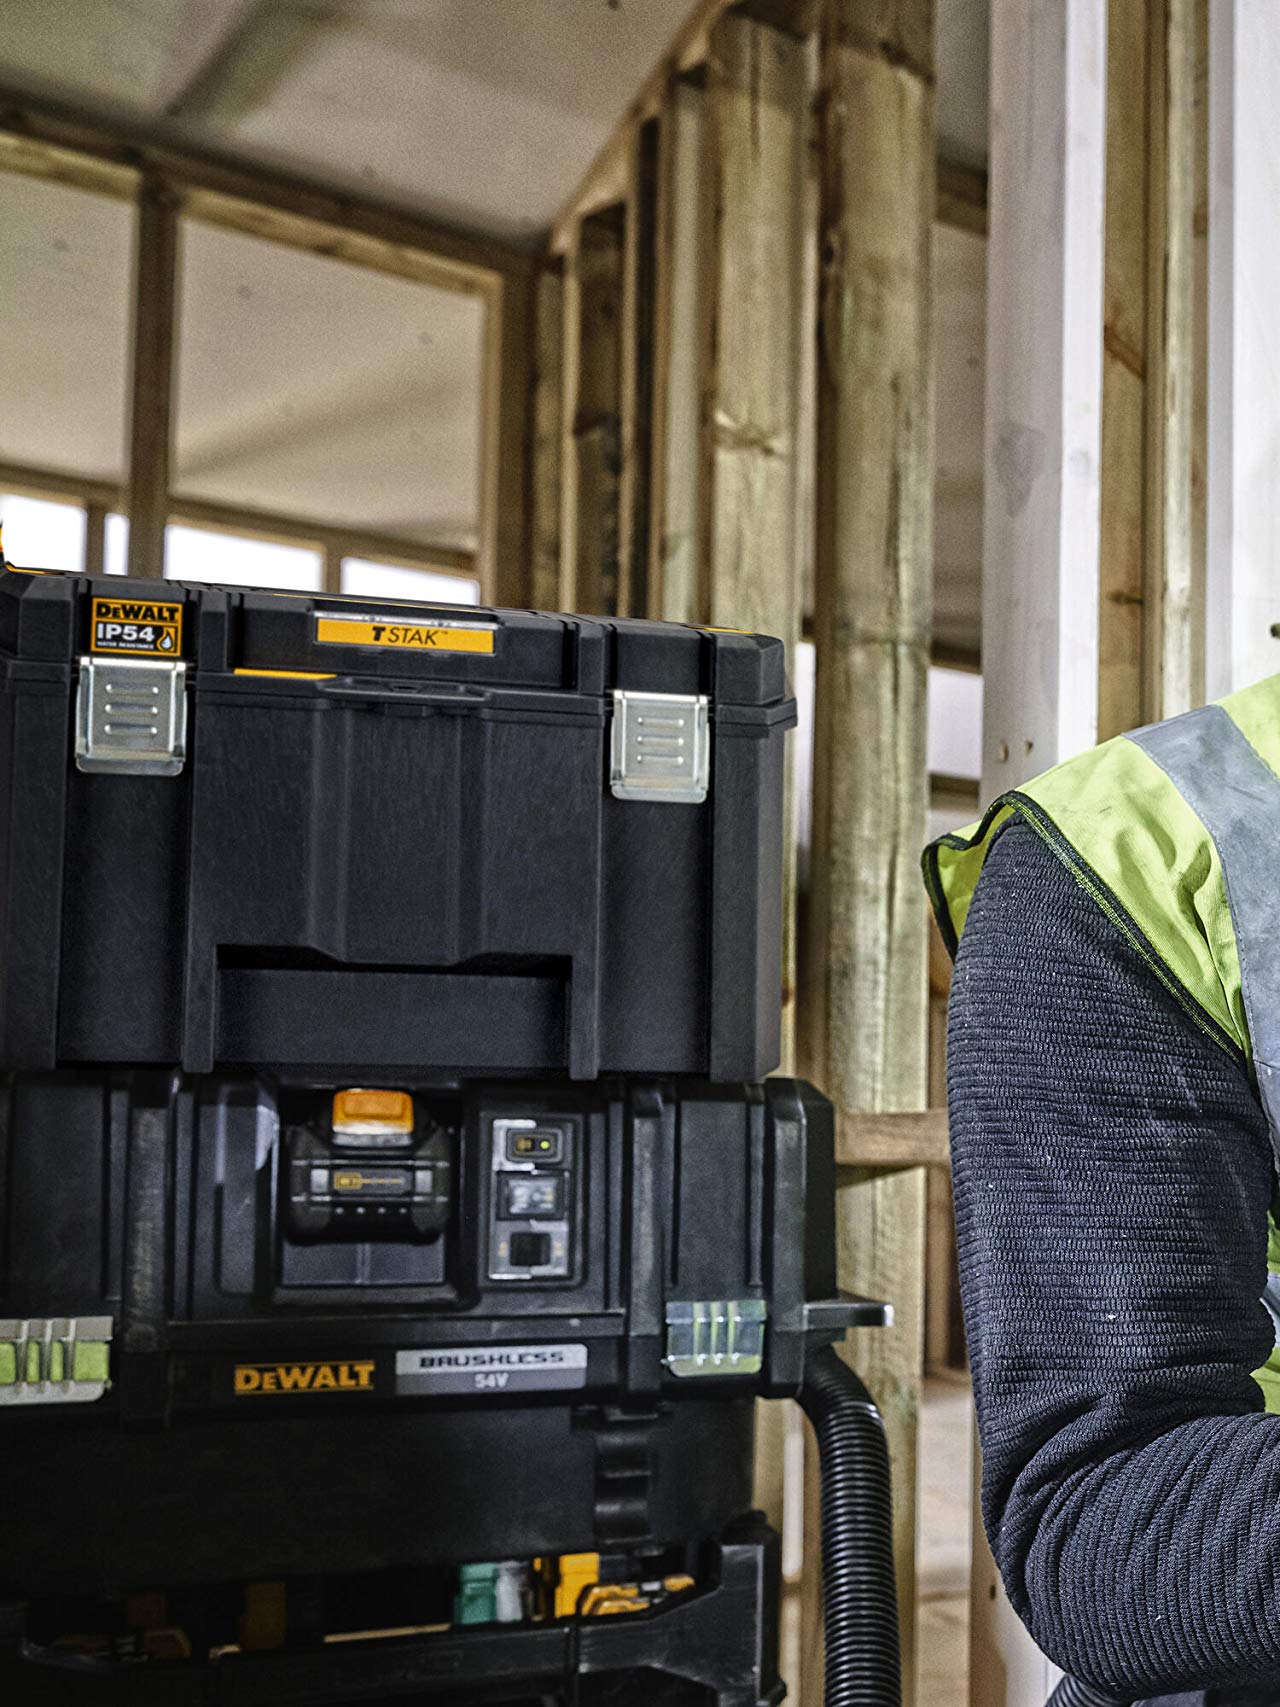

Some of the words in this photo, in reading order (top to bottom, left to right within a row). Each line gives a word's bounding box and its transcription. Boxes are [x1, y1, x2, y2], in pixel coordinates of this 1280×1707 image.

[97, 603, 178, 621] DEWALT
[98, 623, 155, 642] IP54
[419, 1351, 564, 1368] BRUSHLESS
[235, 1363, 374, 1391] DEWALT
[474, 1373, 508, 1388] 54V
